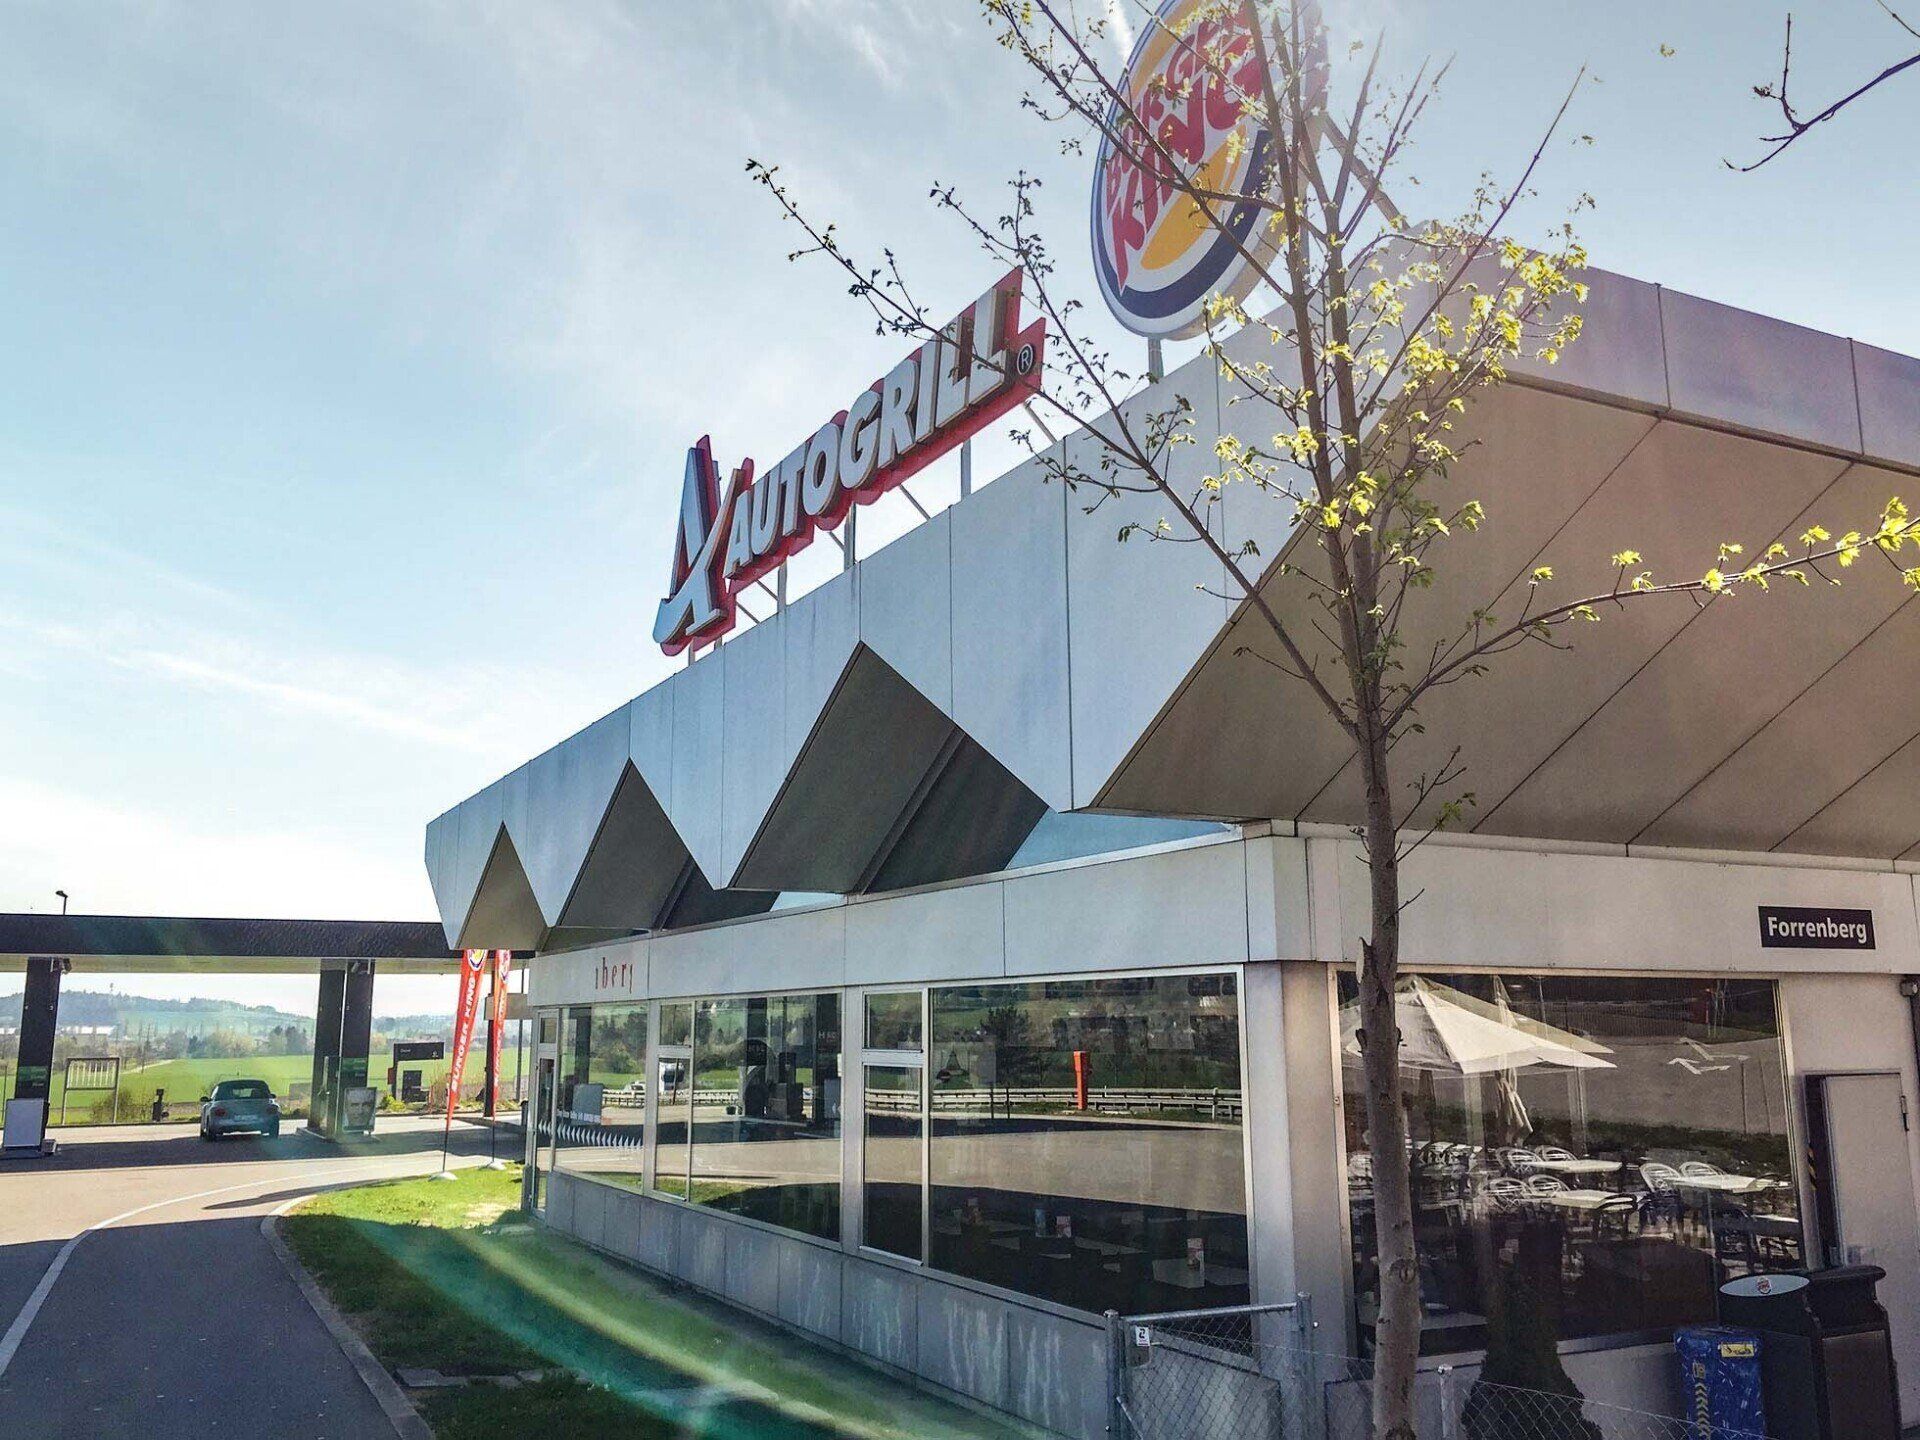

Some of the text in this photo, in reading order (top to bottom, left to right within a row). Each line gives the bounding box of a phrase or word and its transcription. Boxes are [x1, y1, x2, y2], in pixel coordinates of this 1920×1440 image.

[1112, 32, 1262, 290] KING
[722, 284, 1008, 582] AUTOGRILL
[1767, 916, 1868, 944] Forrenberg
